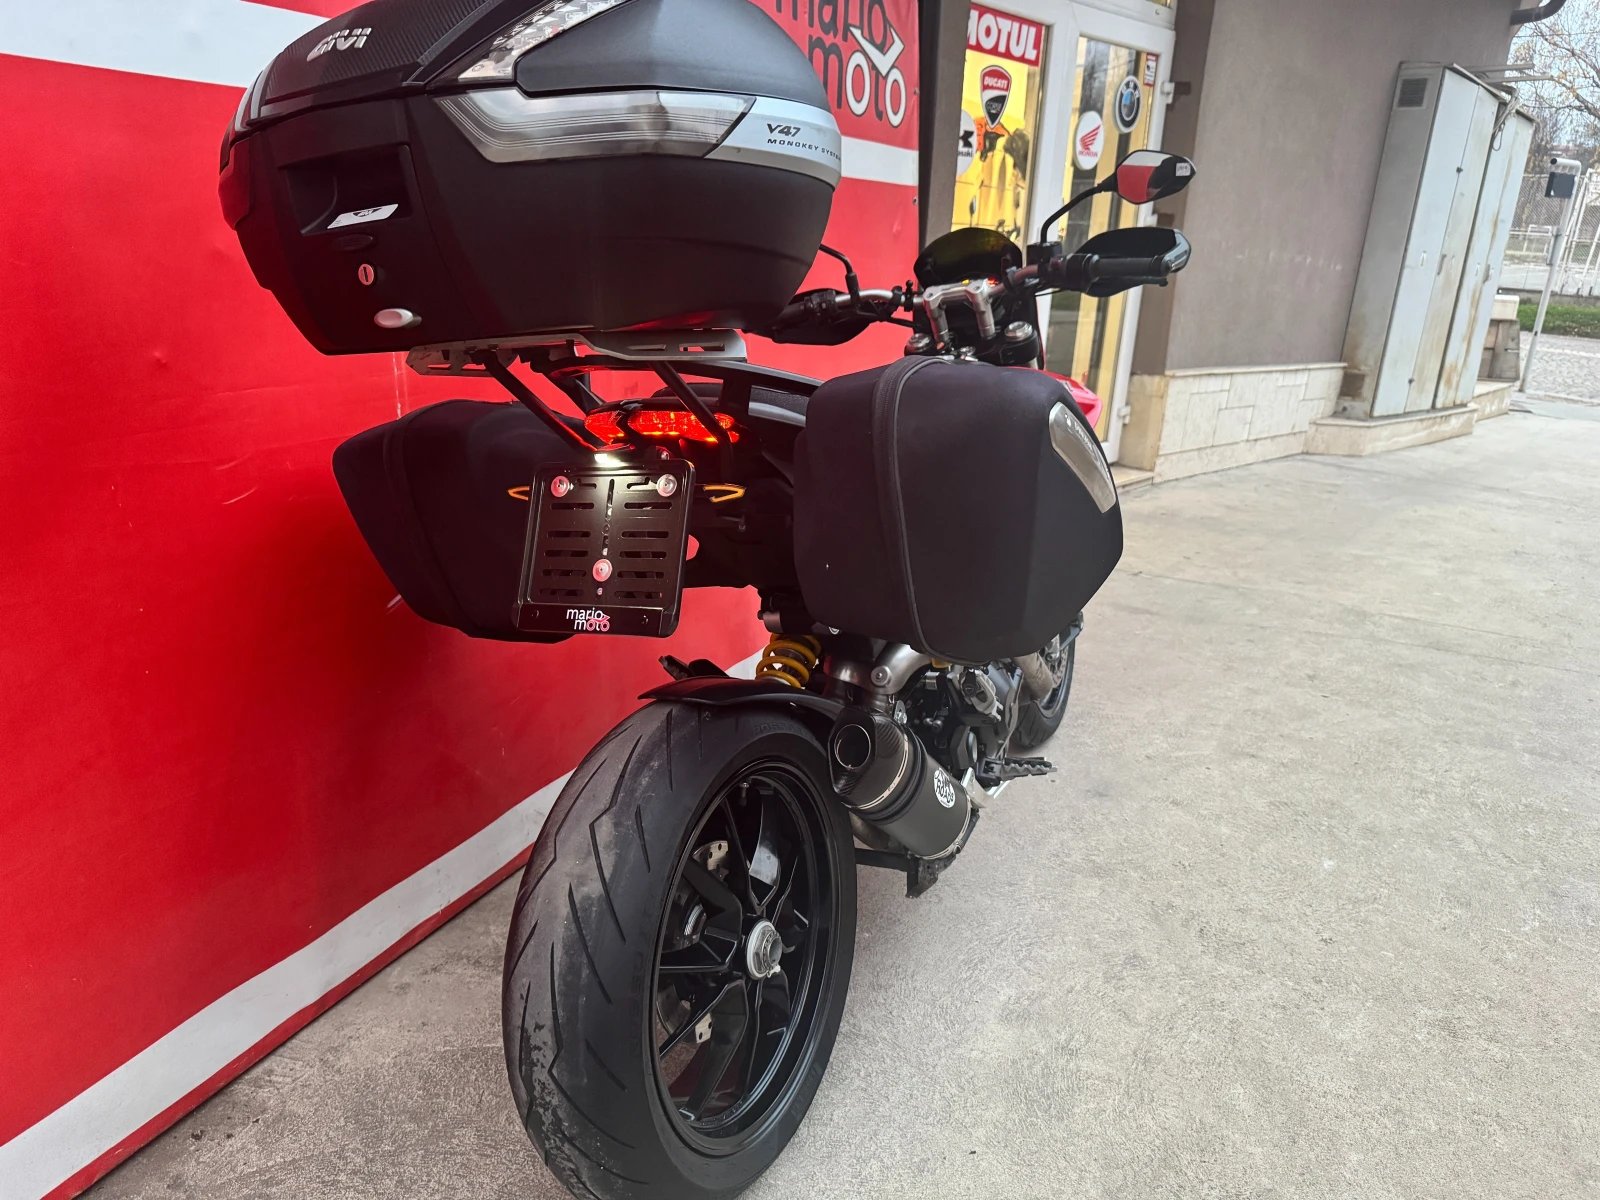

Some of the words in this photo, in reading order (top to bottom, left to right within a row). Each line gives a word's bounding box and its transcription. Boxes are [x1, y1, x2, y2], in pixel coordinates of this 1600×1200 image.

[306, 27, 372, 62] GIVI
[808, 34, 907, 129] moto
[983, 76, 1008, 89] DUCATI
[766, 123, 801, 137] V47
[767, 138, 819, 151] MONOKEY
[1078, 150, 1098, 158] HONDA
[566, 606, 604, 621] mario
[574, 619, 610, 632] moto
